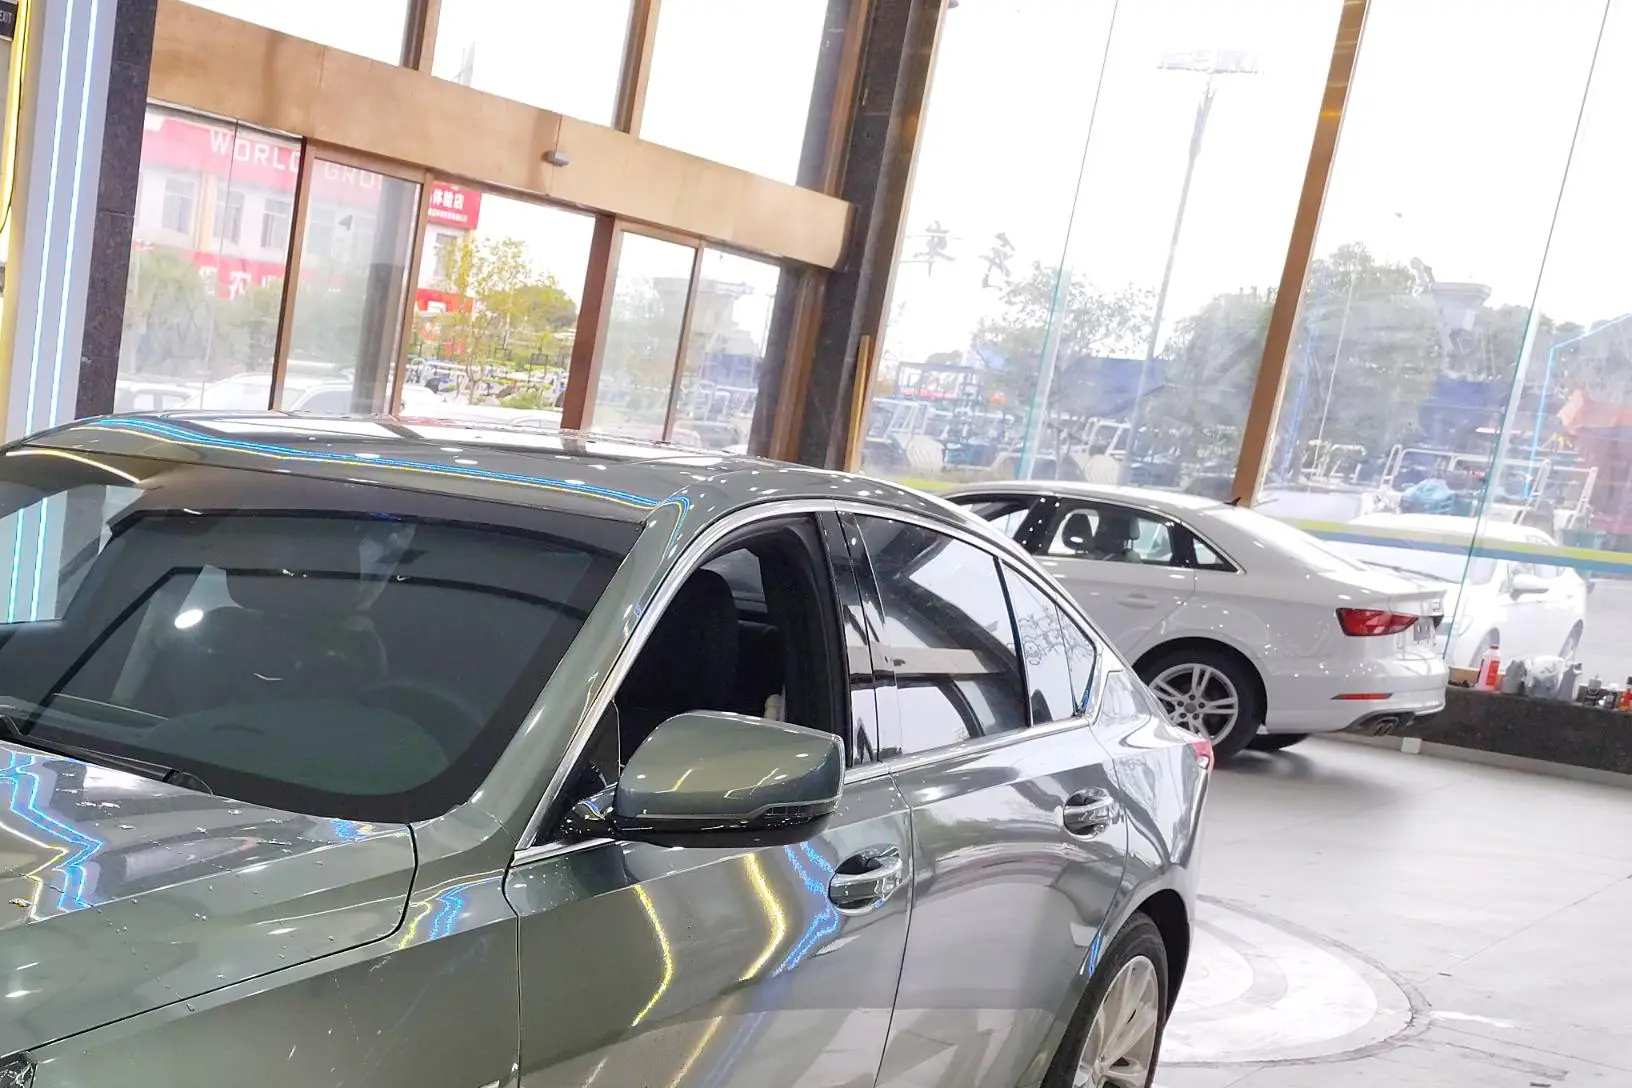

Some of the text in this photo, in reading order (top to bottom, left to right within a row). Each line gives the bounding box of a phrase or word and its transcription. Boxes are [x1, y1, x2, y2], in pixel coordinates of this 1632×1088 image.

[324, 162, 383, 189] GRO
[430, 188, 465, 210] 体验店
